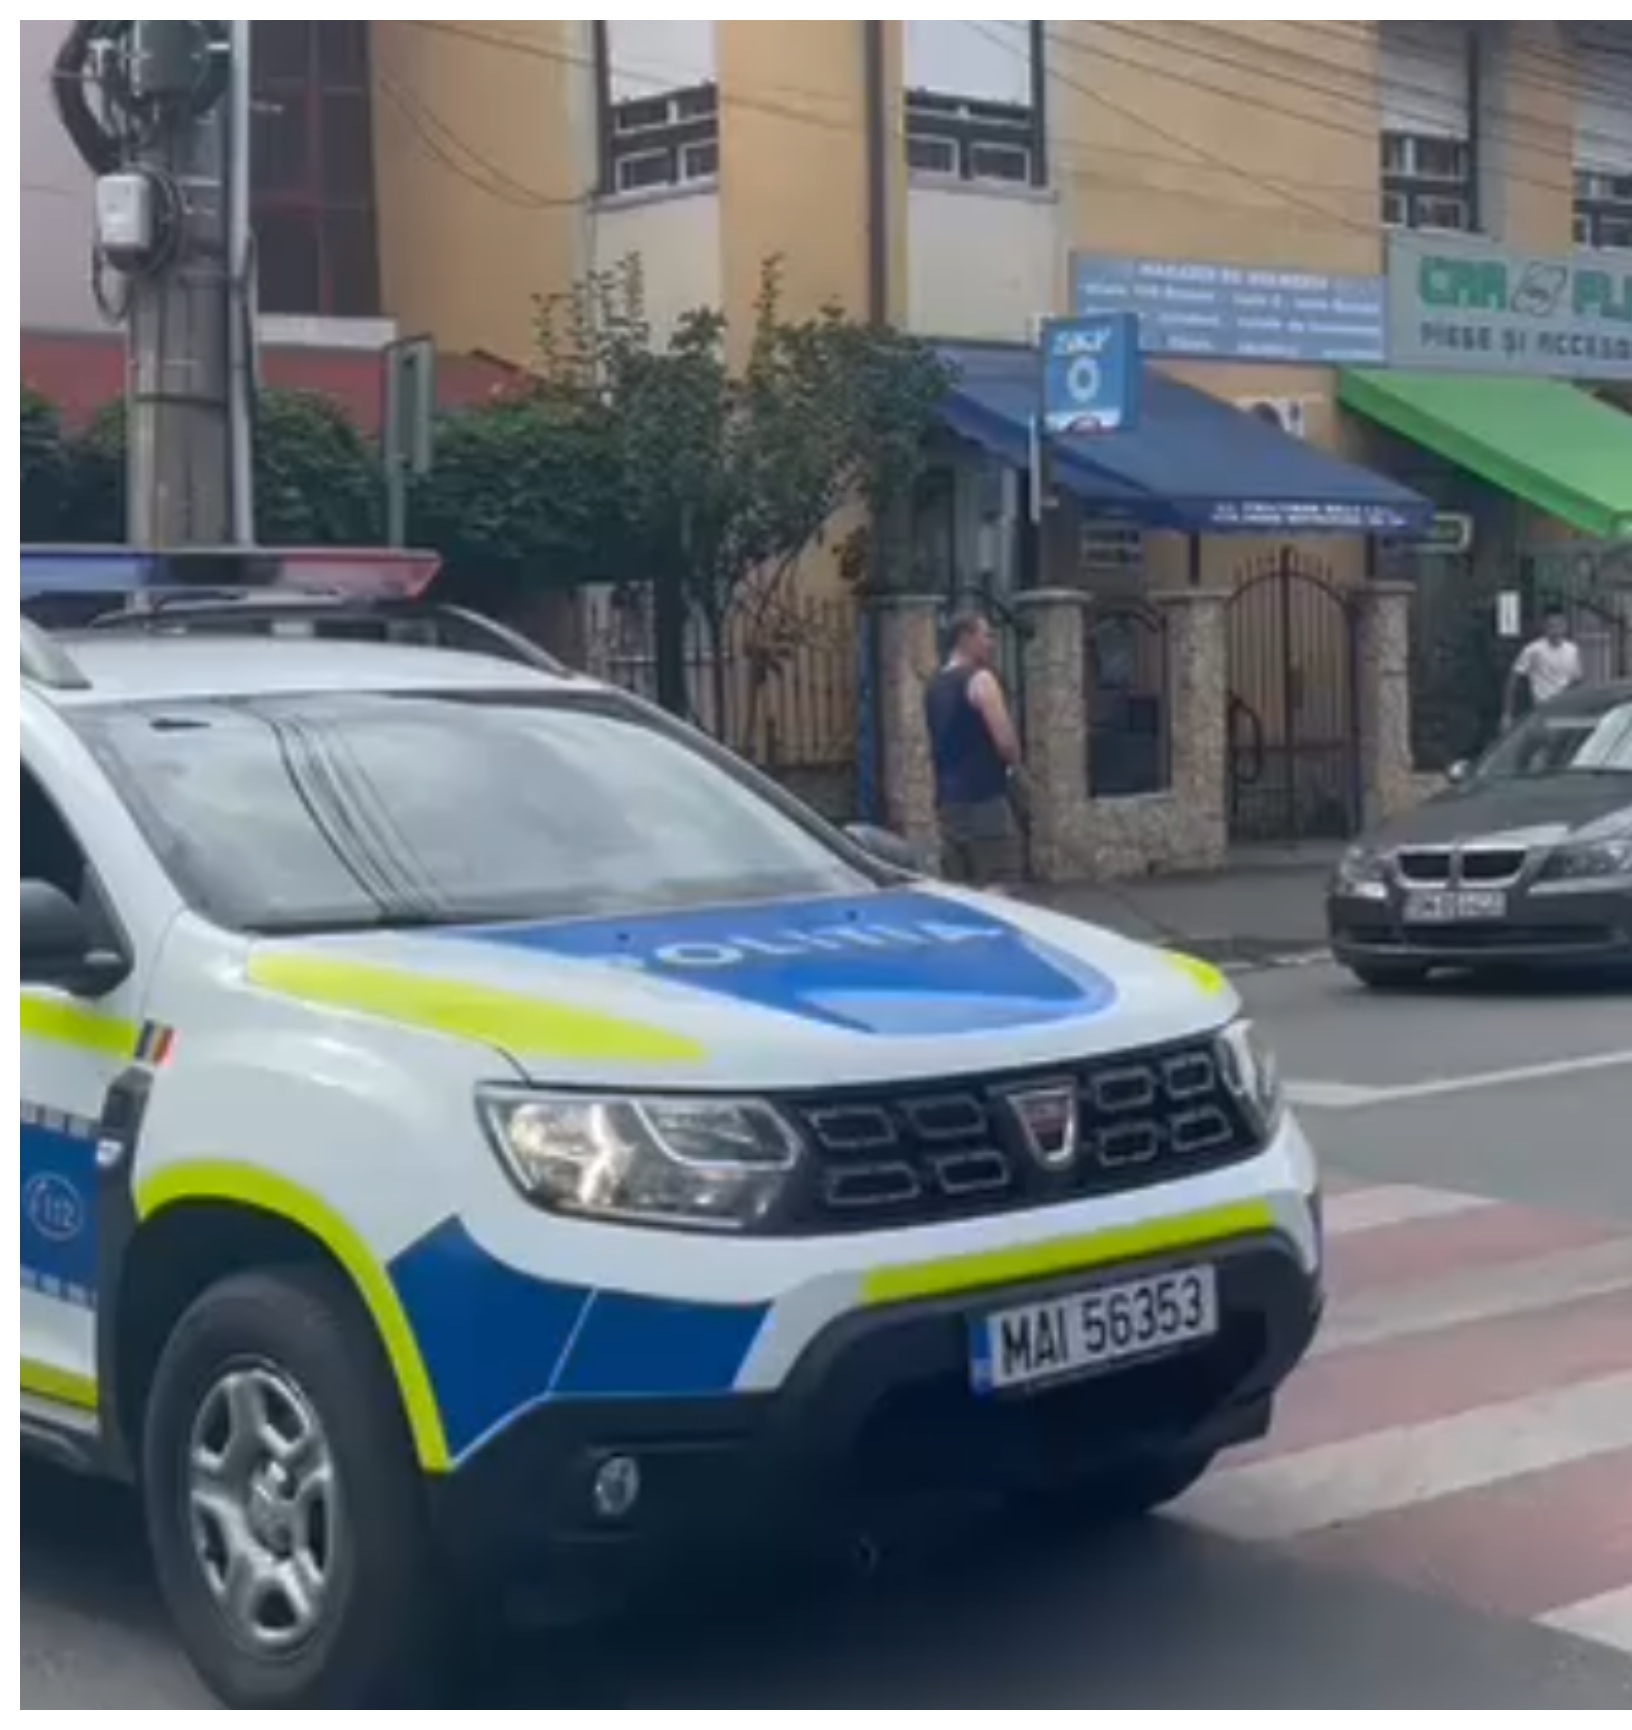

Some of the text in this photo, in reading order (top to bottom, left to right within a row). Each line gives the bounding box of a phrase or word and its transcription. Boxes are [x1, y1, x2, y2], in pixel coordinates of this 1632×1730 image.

[1420, 256, 1507, 311] CAR
[1420, 321, 1492, 351] PIESE
[1001, 1275, 1203, 1376] MAI 56353
